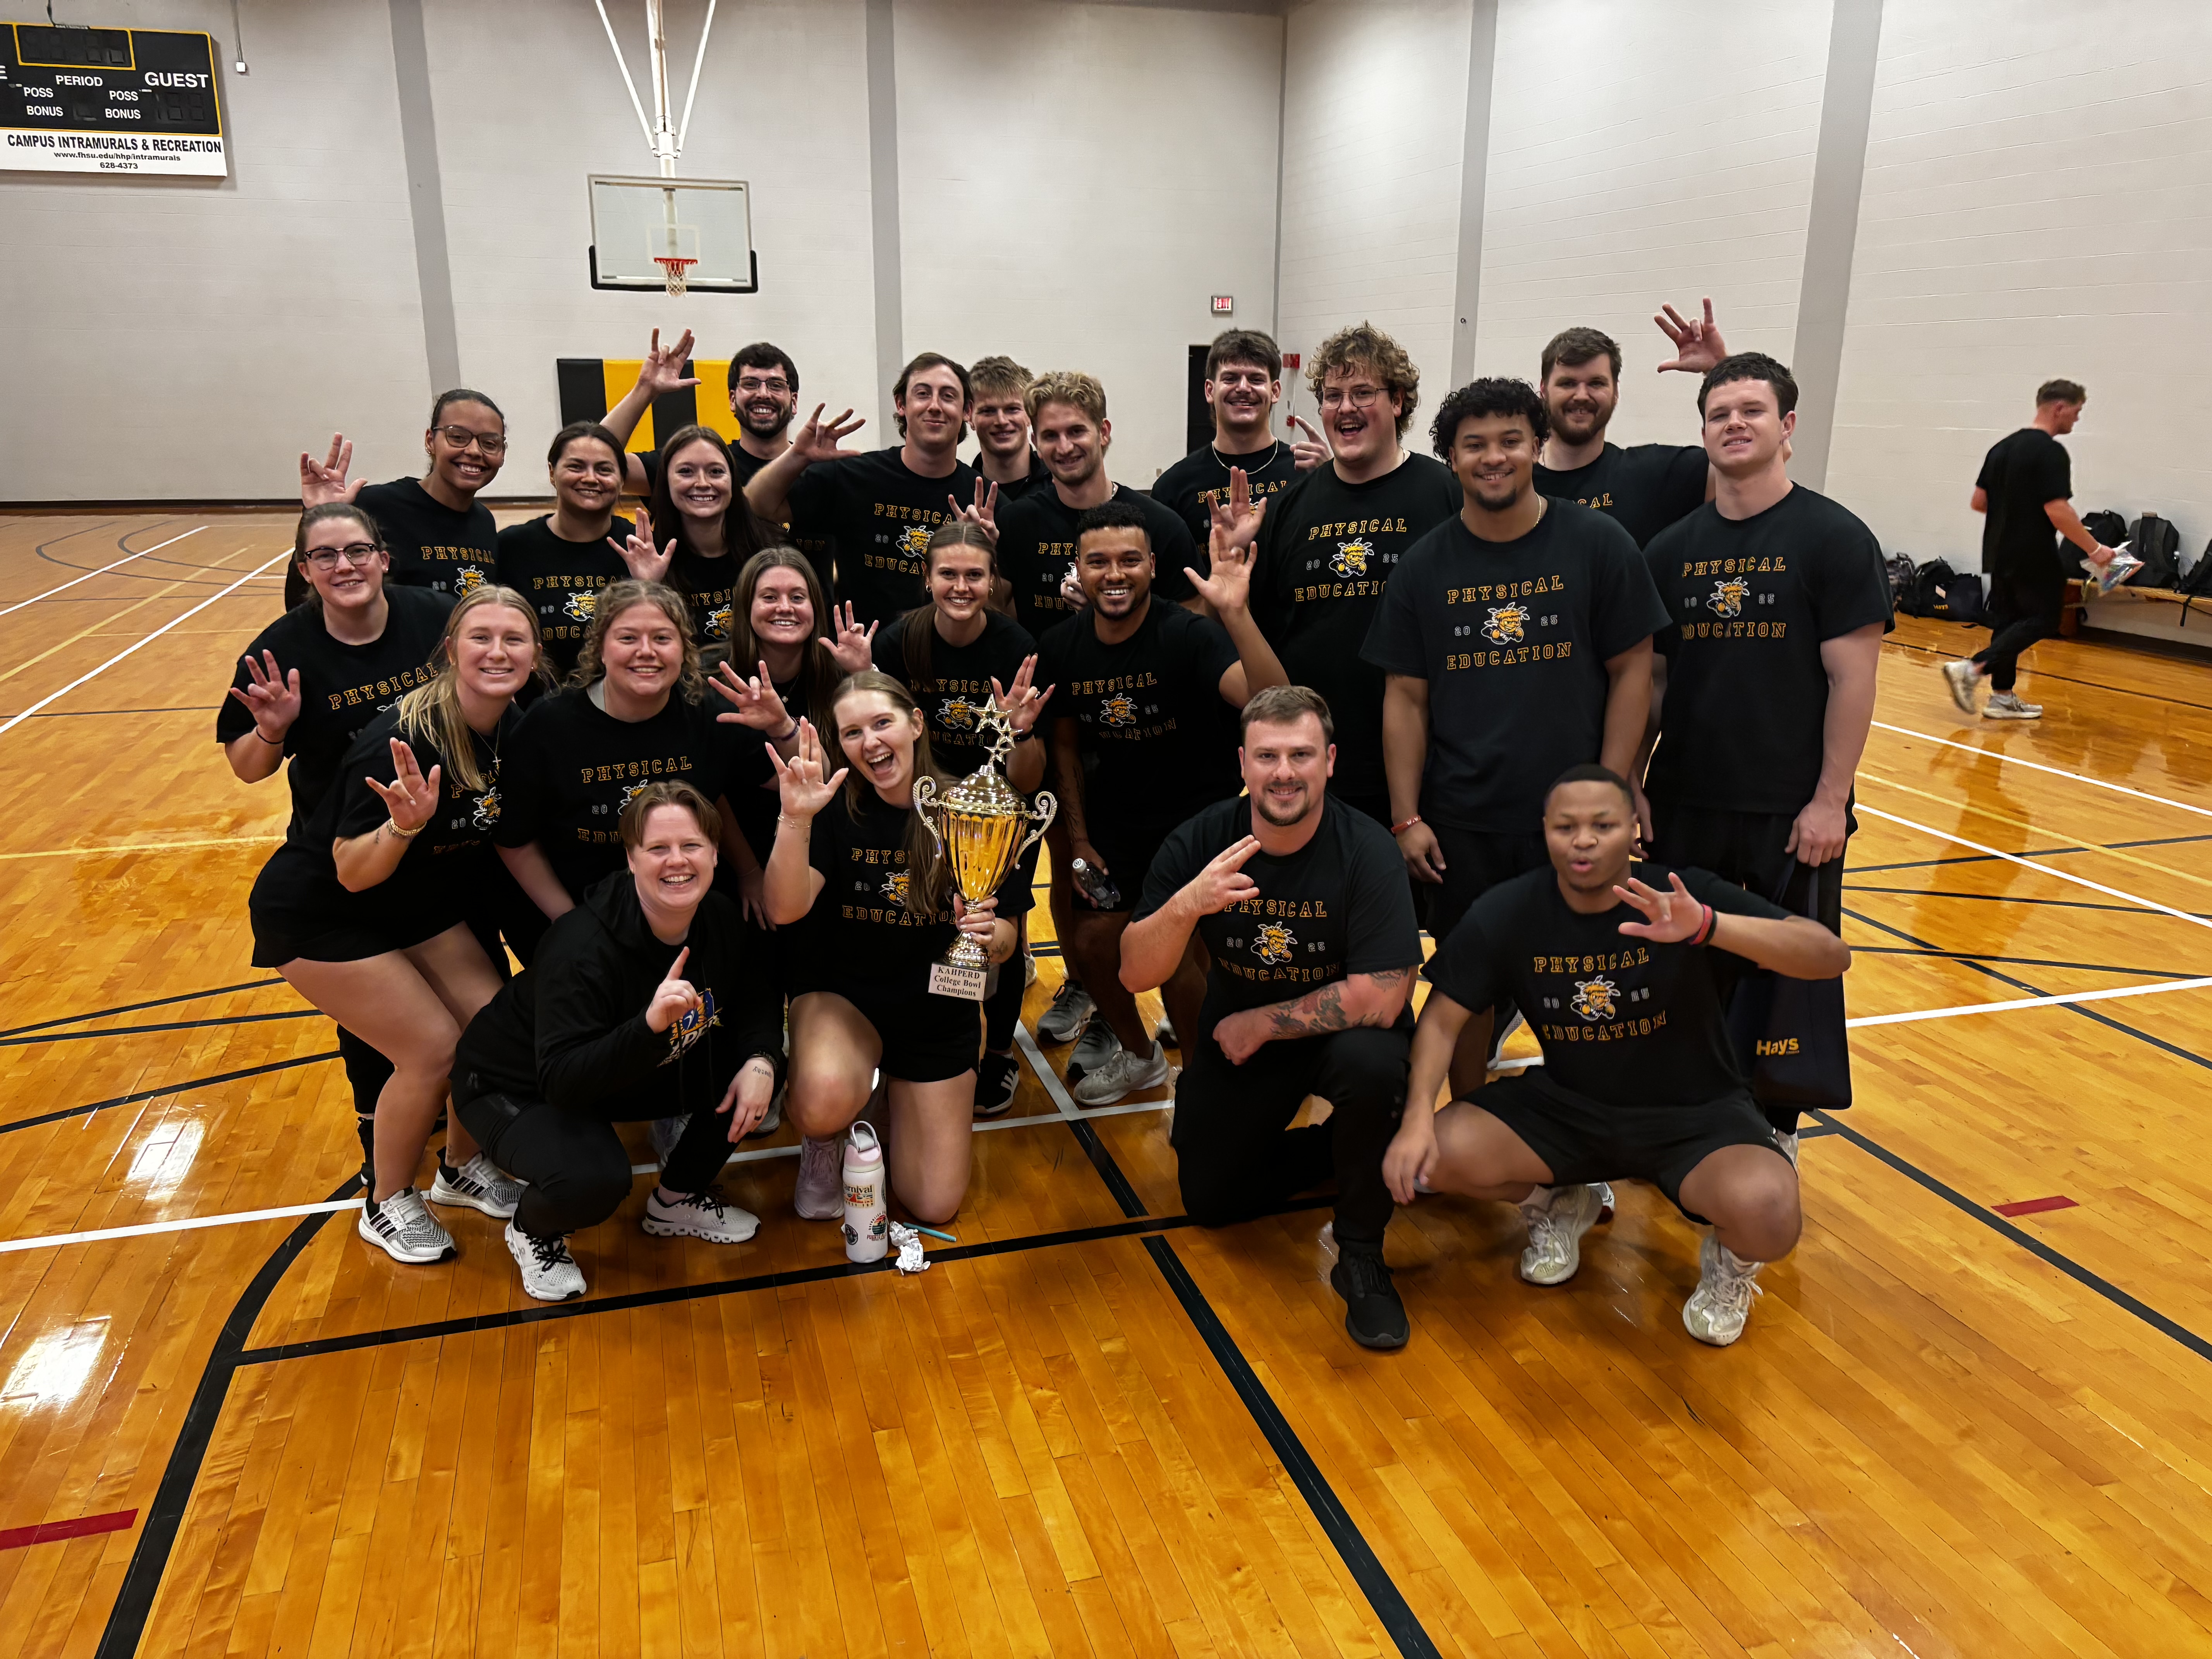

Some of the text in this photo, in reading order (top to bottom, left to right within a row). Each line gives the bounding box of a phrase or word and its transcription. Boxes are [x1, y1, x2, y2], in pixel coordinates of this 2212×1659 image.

[55, 75, 103, 87] PERIOD
[144, 72, 209, 88] GUEST
[24, 87, 53, 98] POSS
[109, 90, 139, 101] POSS
[27, 105, 64, 116] BONUS
[105, 108, 141, 119] BONUS
[7, 134, 222, 153] CAMPUS INTRAMURALS & RECREATION
[54, 151, 181, 161] www.fhsu.edu/hhp/intramurals
[874, 503, 953, 526] PHYSICA
[1308, 517, 1407, 541] PHYSICAL
[421, 546, 495, 565] PHYSICAL
[864, 553, 920, 575] EDUCA
[1682, 556, 1786, 578] PHYSICAL
[533, 575, 621, 590] PHYSICA
[1295, 580, 1386, 602] EDUCATI
[1447, 575, 1564, 604] PHYSICAL
[1455, 615, 1558, 636] 20 25
[1447, 642, 1572, 670] EDUCATION
[328, 663, 438, 710] PHYSICAL
[1072, 672, 1157, 696] PHYSICAL
[581, 756, 692, 783] PHYSICAL
[852, 847, 906, 864] PHYS
[1218, 957, 1341, 982] EDUCATION
[1534, 947, 1650, 973] PHYSICAL
[934, 975, 981, 989] College Bowl
[938, 967, 980, 979] KAHPERD
[937, 984, 976, 996] Champions
[1756, 1038, 1799, 1056] Hays
[844, 1184, 872, 1193] arnival
